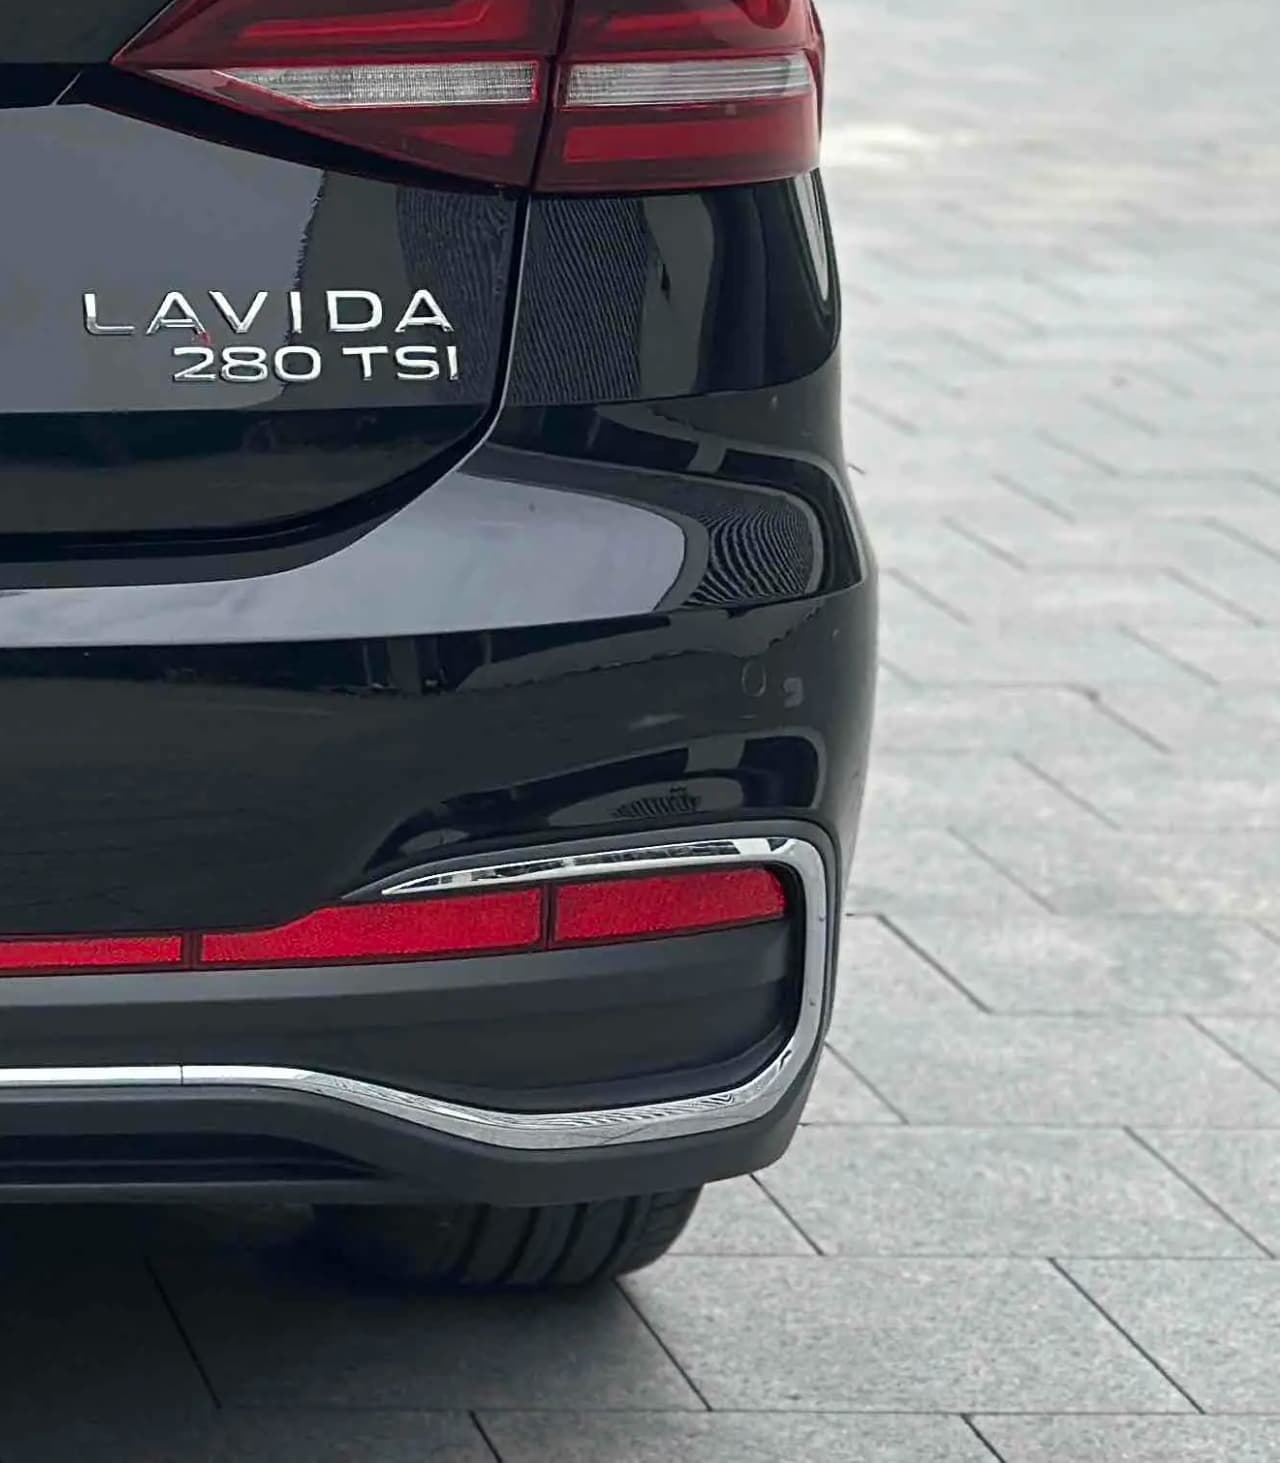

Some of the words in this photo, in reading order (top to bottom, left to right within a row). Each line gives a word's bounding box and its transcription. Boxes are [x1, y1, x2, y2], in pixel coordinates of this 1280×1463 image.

[82, 288, 455, 335] LAVIDA
[171, 345, 322, 382] 280
[342, 344, 460, 381] TSI
